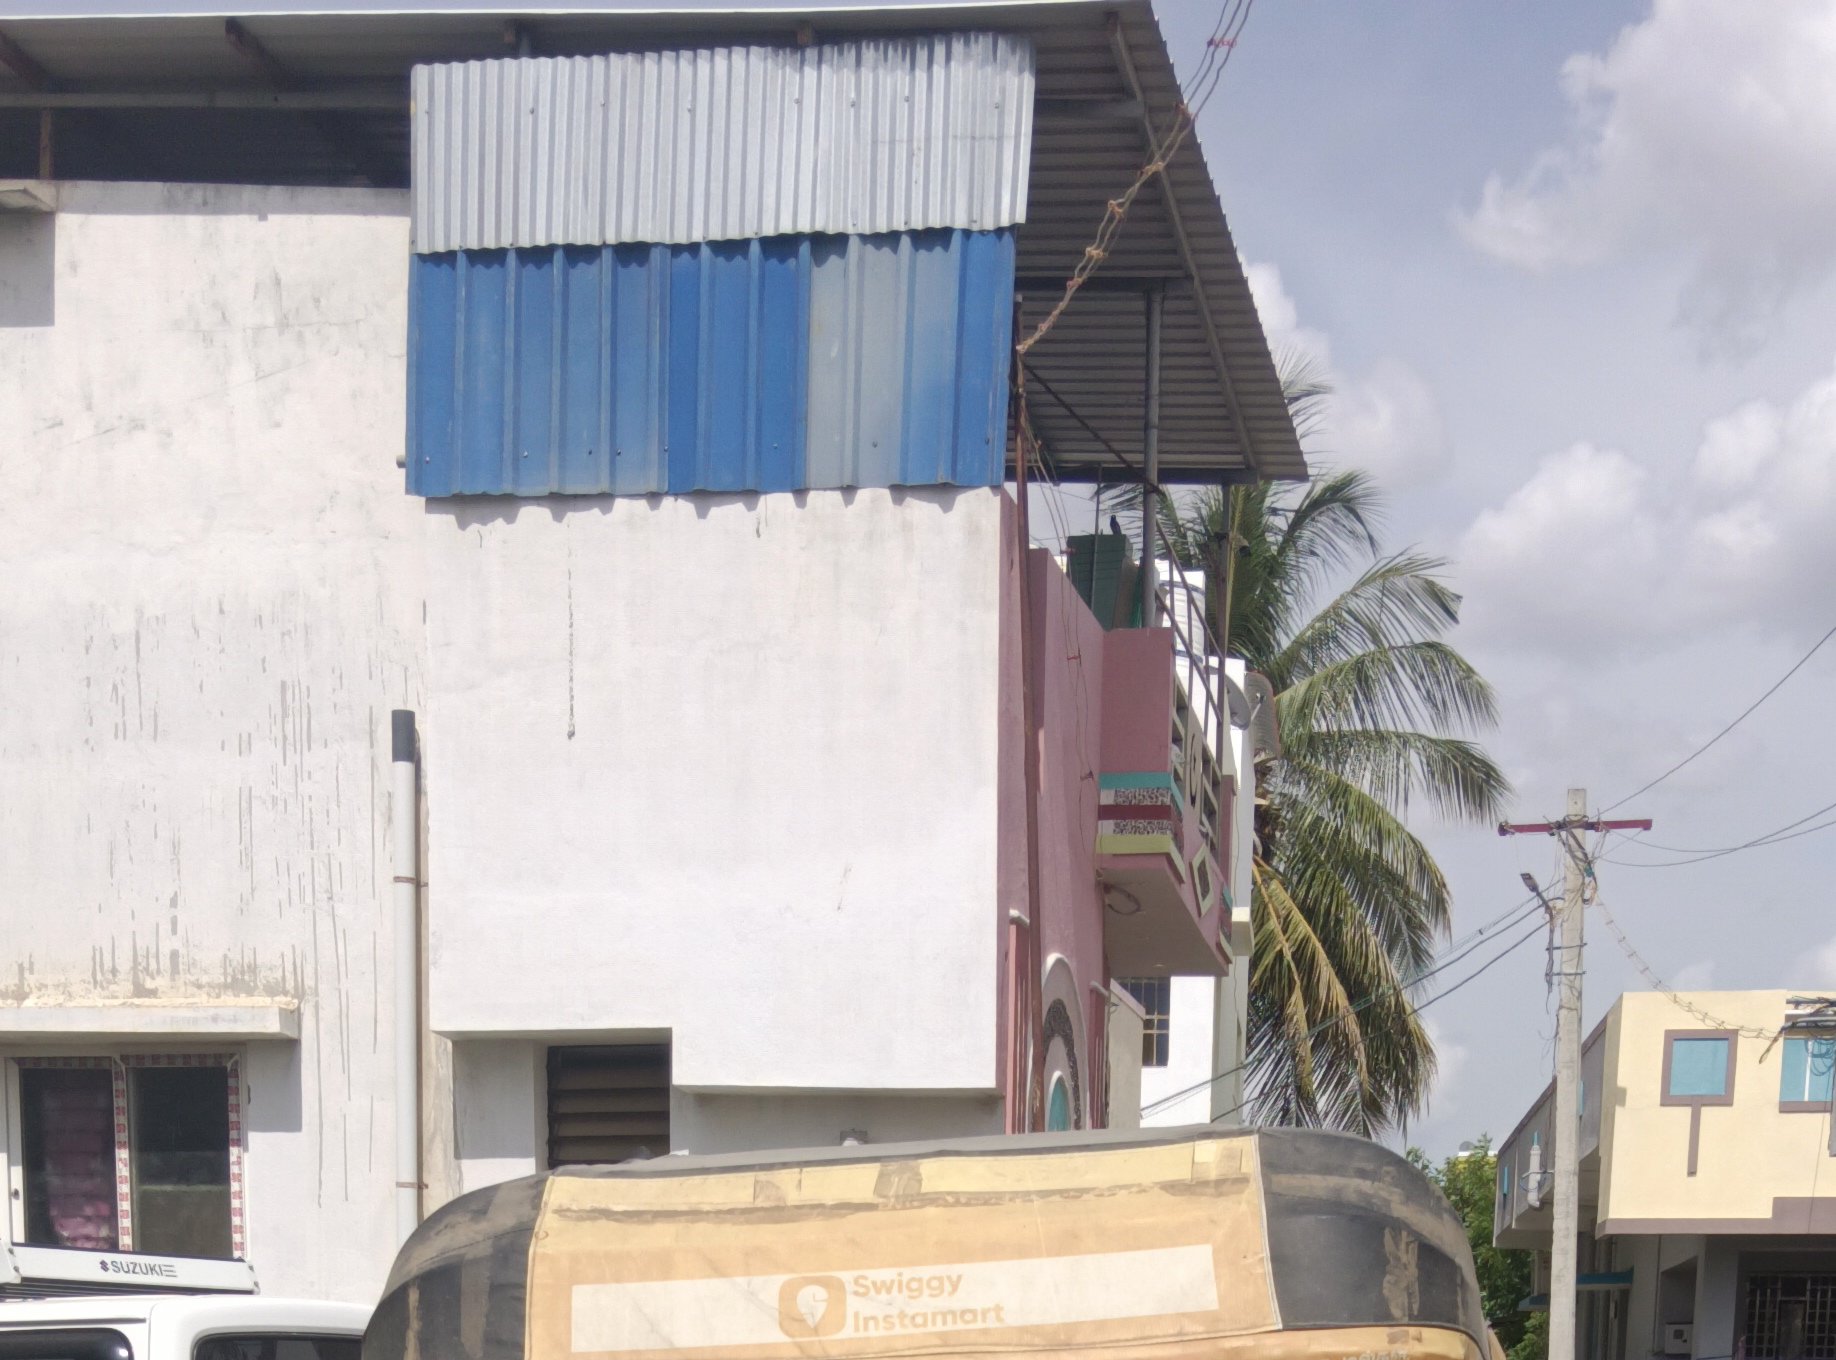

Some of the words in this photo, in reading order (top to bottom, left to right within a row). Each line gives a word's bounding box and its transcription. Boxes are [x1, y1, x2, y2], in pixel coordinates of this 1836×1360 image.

[110, 1260, 164, 1277] SUZUKI
[852, 1272, 962, 1299] Swiggy
[853, 1303, 1005, 1333] Instamart
